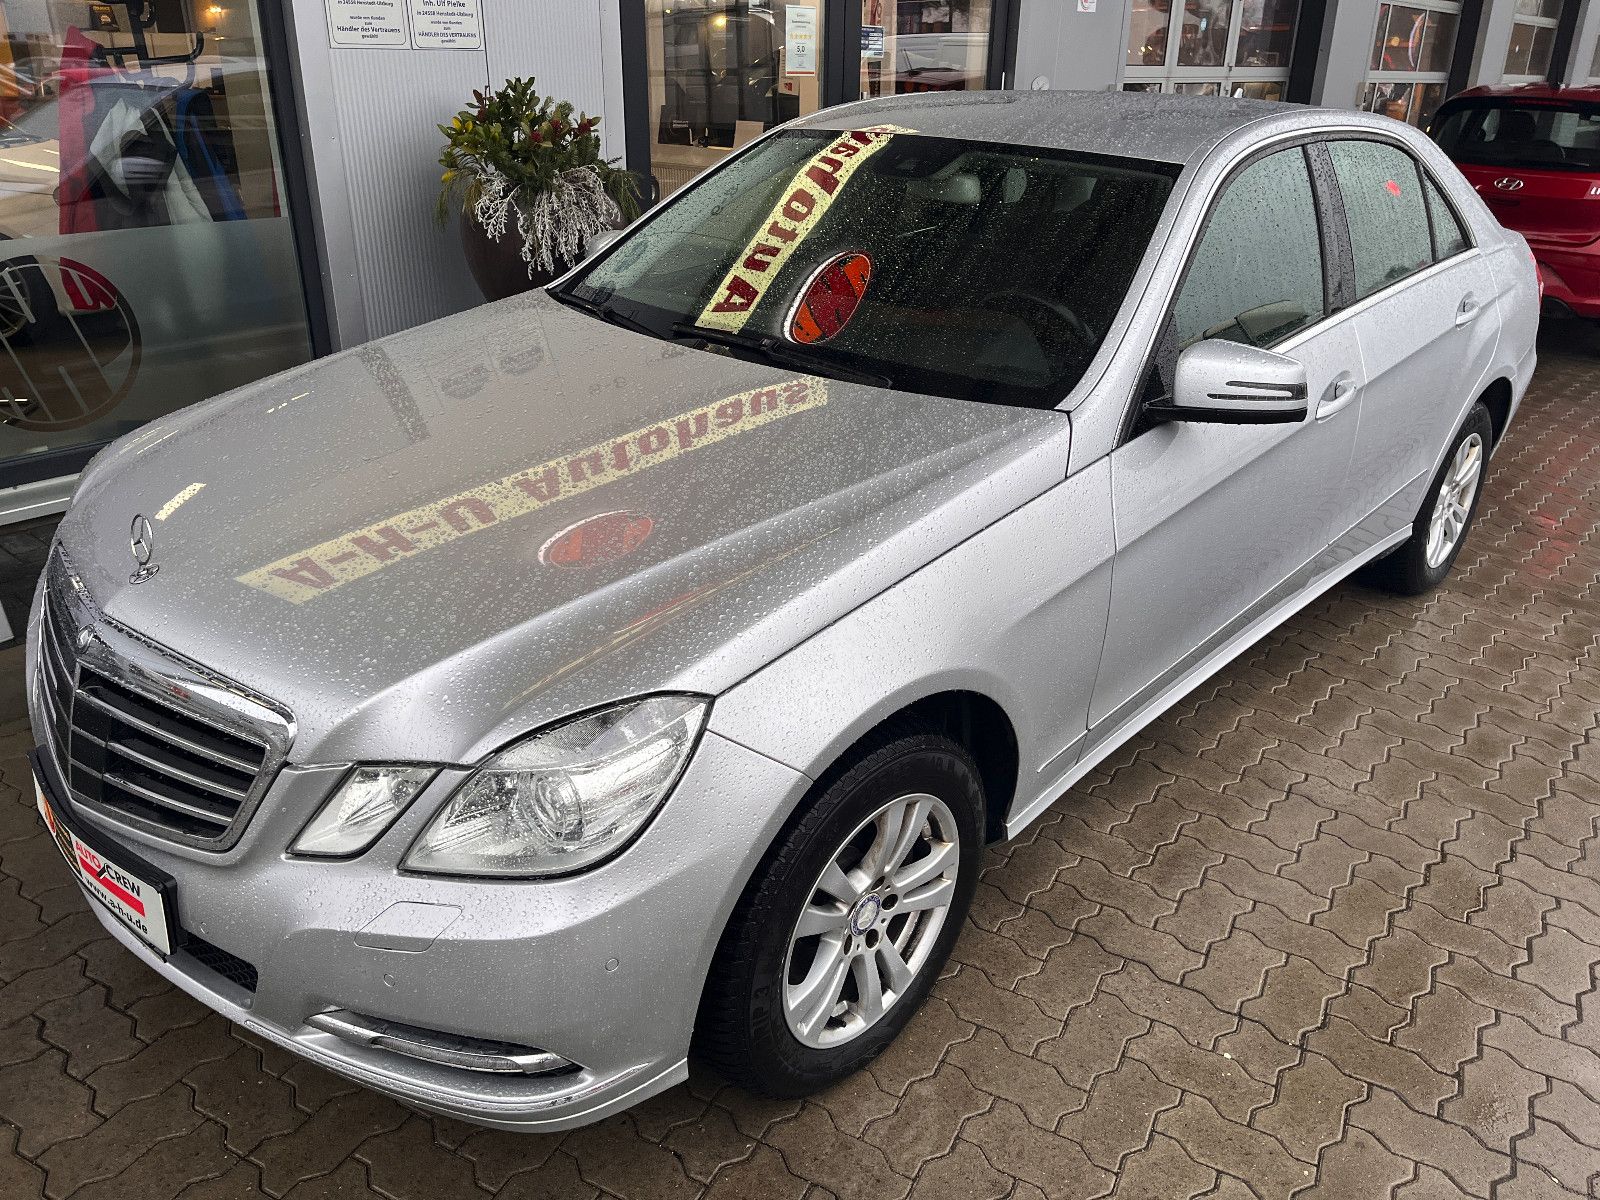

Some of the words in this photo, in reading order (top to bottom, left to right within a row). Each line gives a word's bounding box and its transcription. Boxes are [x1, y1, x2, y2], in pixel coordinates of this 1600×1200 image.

[75, 841, 101, 869] AUTO
[105, 864, 141, 897] CREW
[84, 877, 148, 934] www.a-h-u.de
